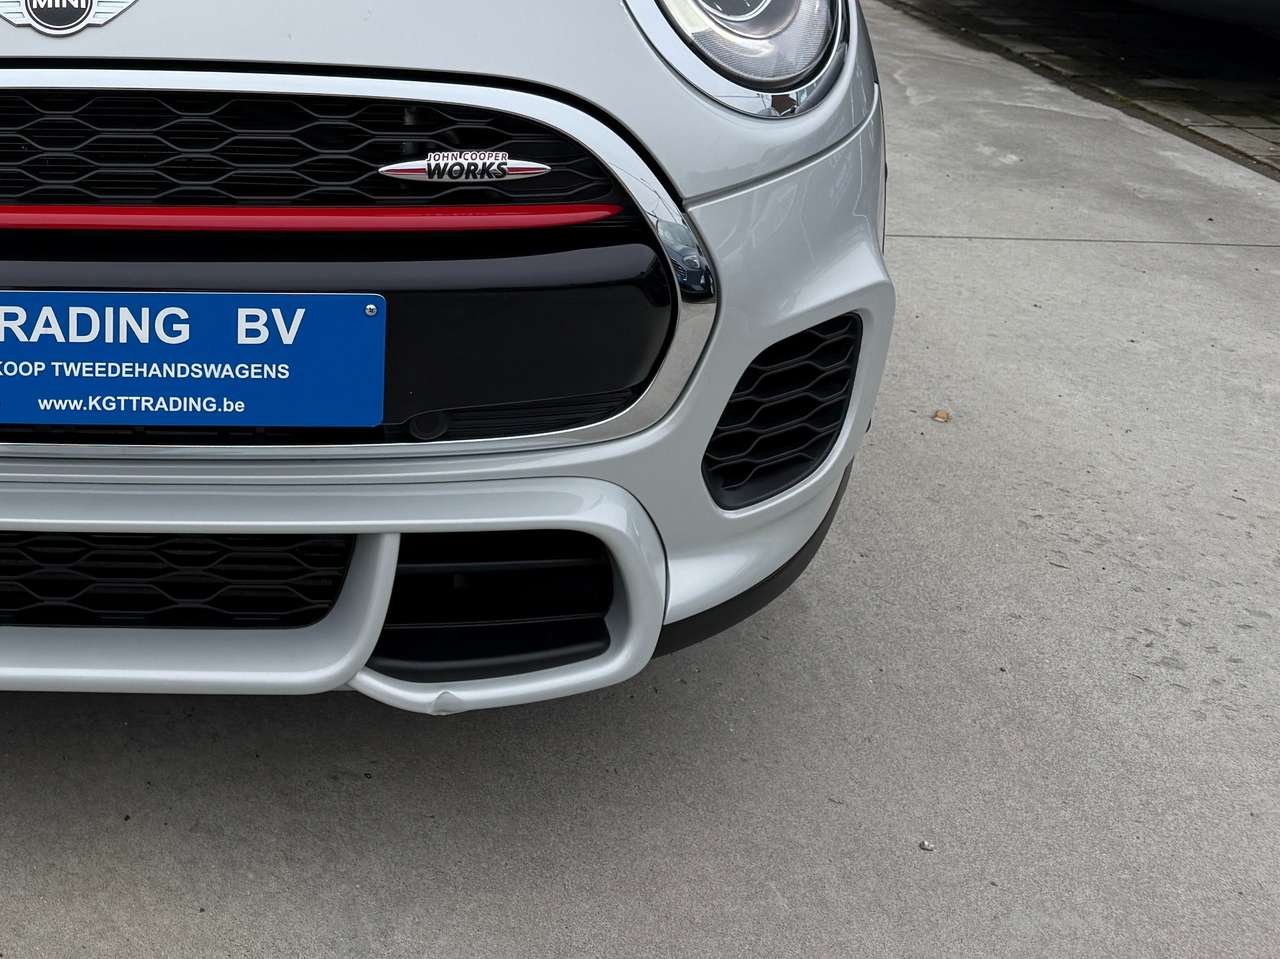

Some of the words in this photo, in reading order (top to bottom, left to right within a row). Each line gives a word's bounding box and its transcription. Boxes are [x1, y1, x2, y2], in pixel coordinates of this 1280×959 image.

[427, 152, 459, 162] JOHN
[463, 151, 508, 161] COOPER
[426, 161, 508, 180] WORKS
[237, 308, 306, 345] BV
[51, 361, 290, 379] TWEEDEHANDSWAGENS
[38, 395, 245, 413] www.KGTTRADING.be
